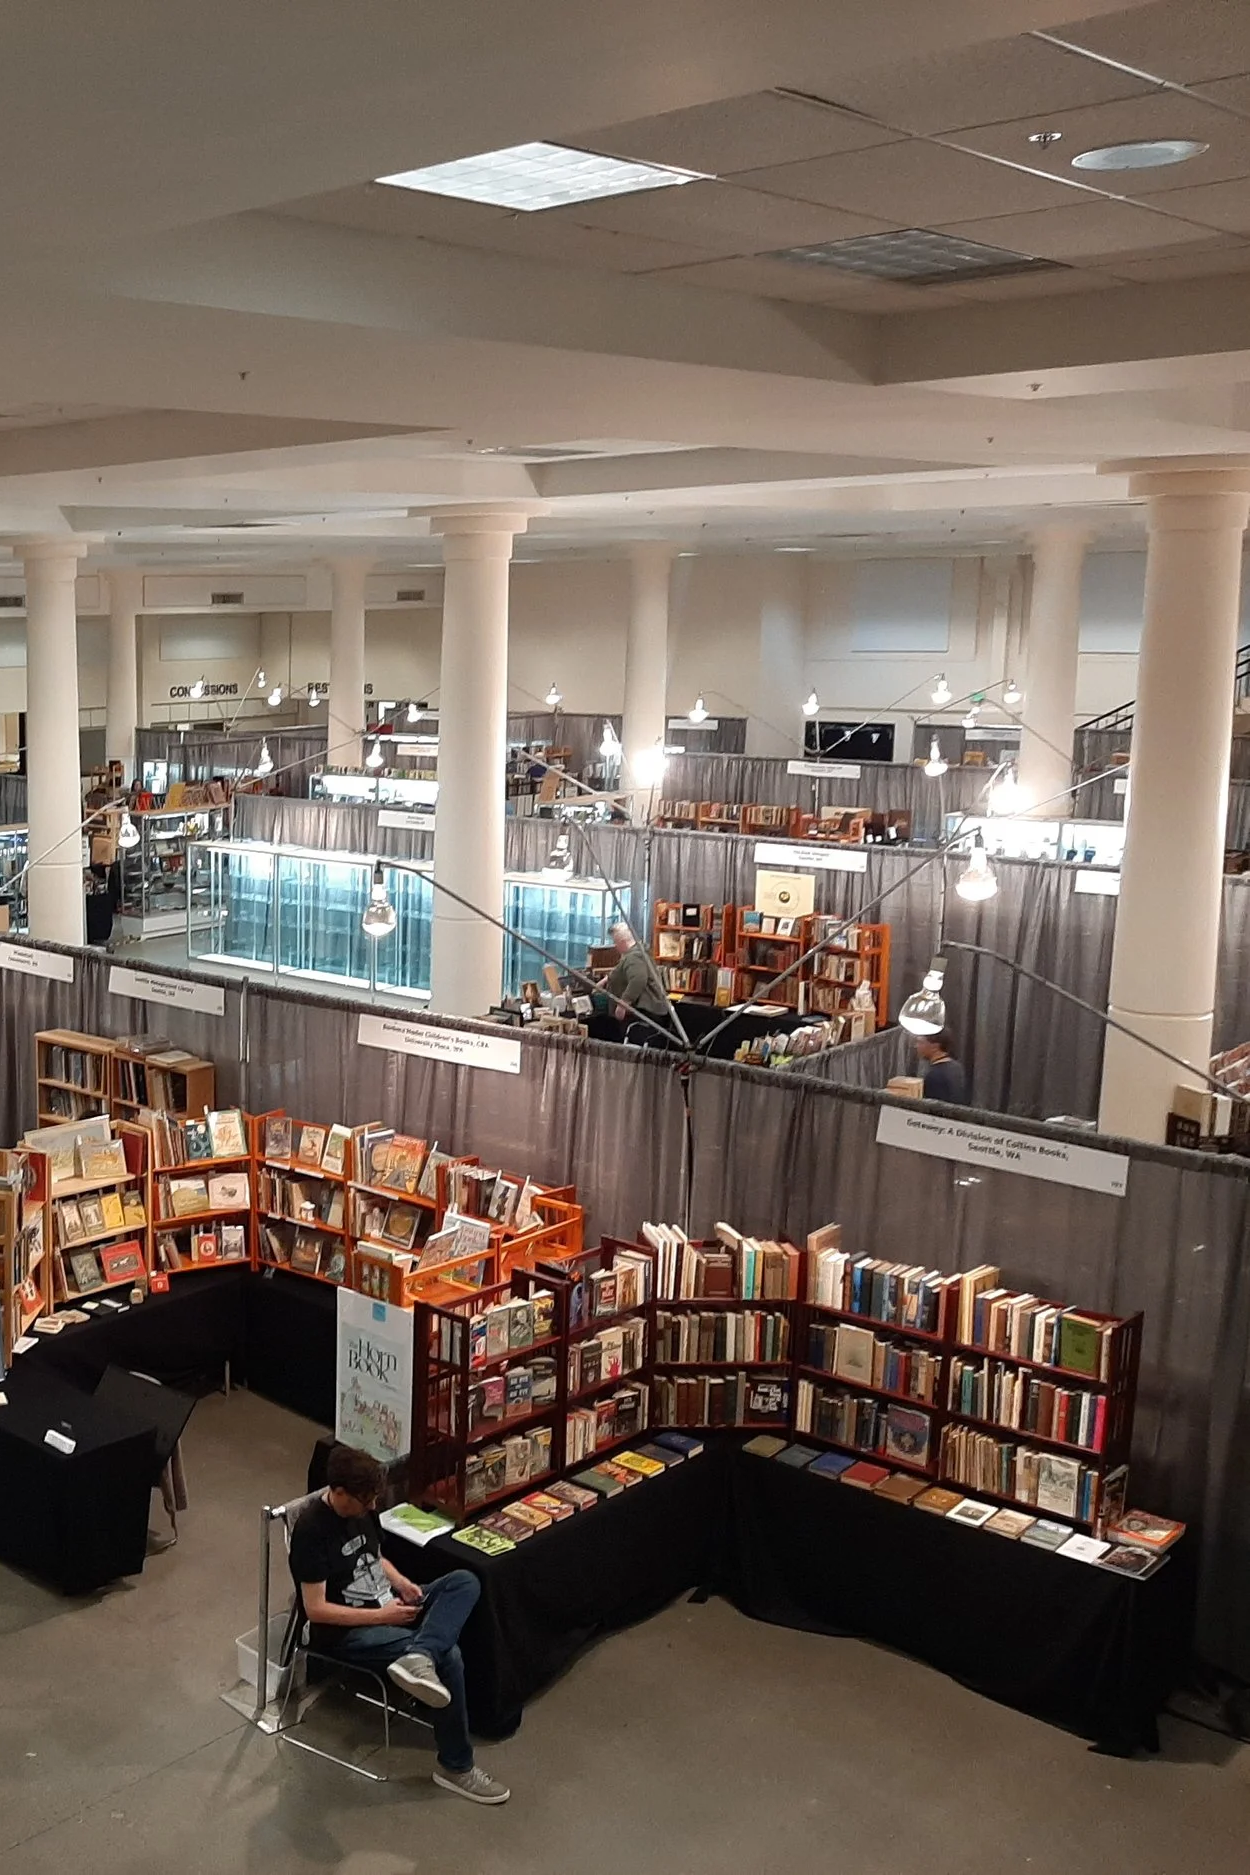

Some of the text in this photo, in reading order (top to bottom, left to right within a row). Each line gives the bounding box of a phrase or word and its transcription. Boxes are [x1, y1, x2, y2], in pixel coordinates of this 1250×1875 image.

[170, 683, 238, 698] CONSSIONS
[947, 1127, 954, 1136] A
[956, 1129, 992, 1143] Division
[993, 1137, 1004, 1146] of
[1005, 1138, 1037, 1153] Collins
[1038, 1145, 1069, 1161] Books,
[967, 1142, 1021, 1161] Seattle, WA
